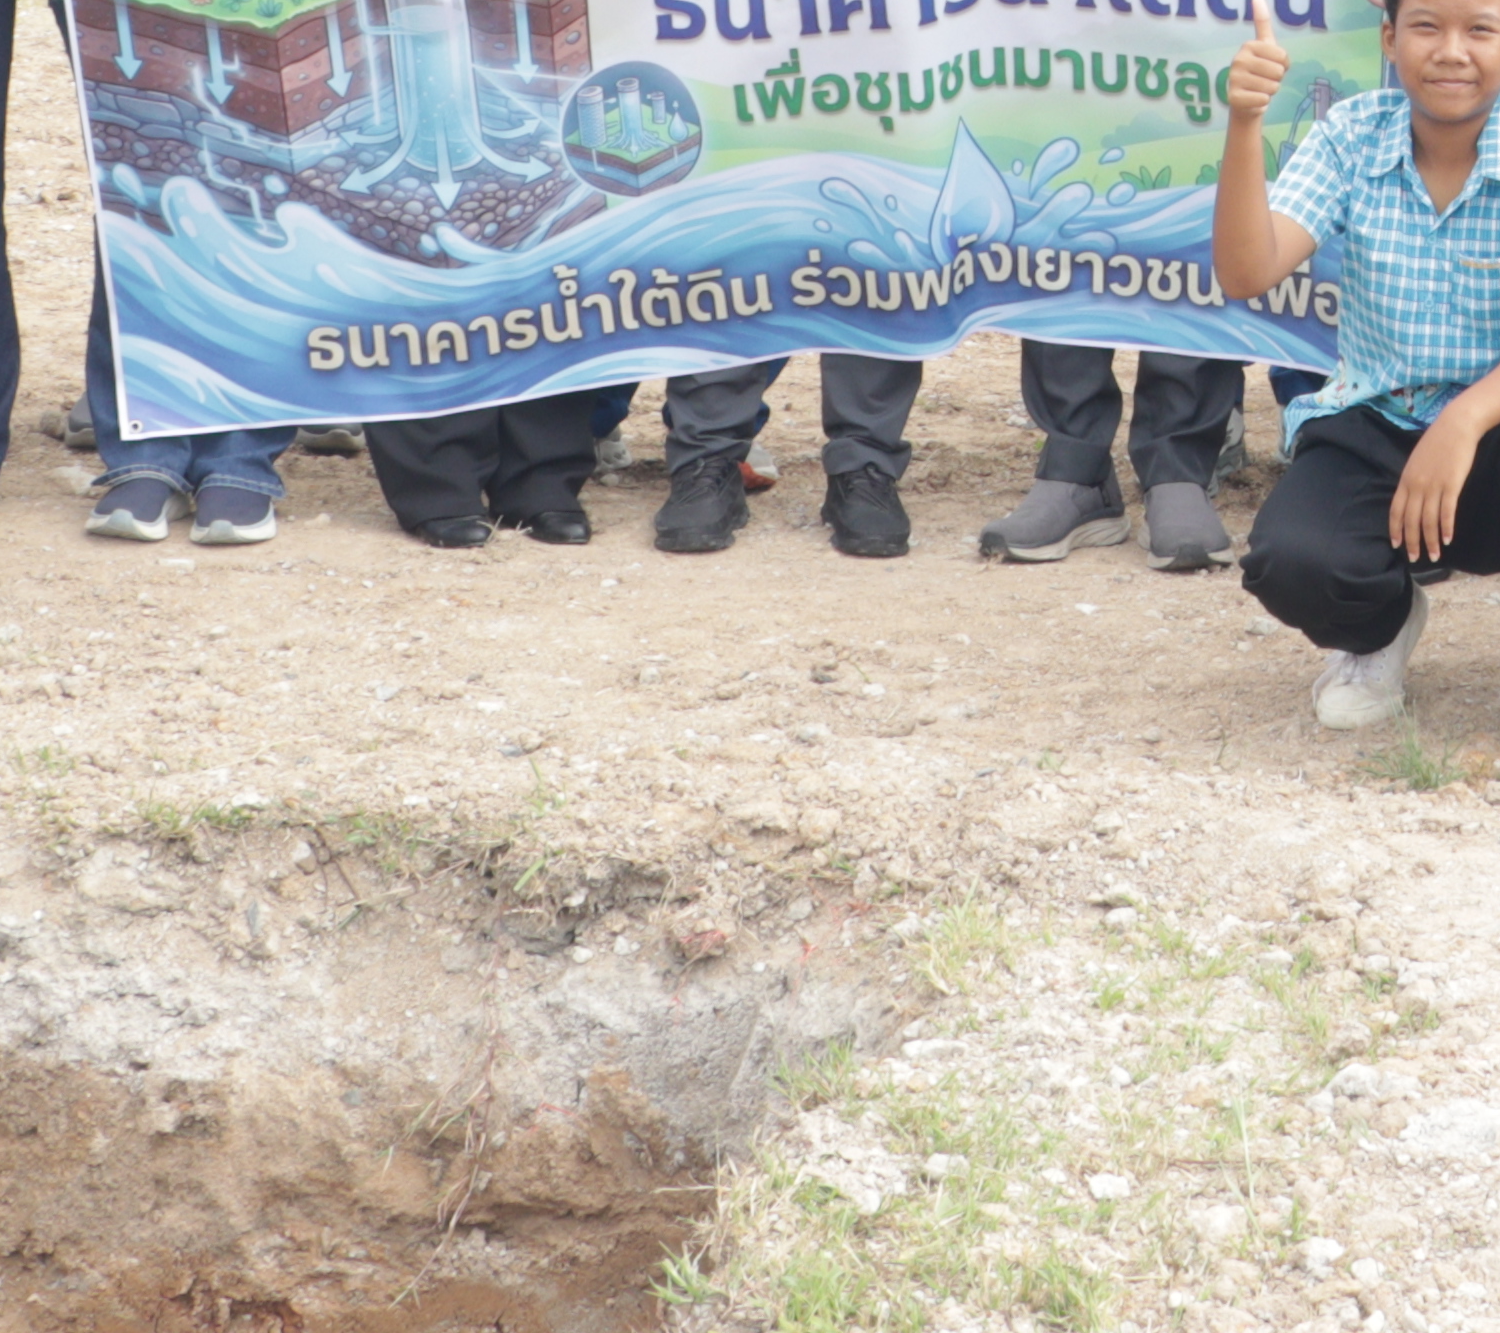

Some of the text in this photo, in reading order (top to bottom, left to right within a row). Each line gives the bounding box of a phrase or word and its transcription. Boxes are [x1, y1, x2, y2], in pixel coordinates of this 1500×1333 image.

[733, 46, 1233, 130] เพื่อชุมชนมาบชลู
[308, 265, 773, 371] ธนาคารน้ำใต้ดิน
[790, 235, 1225, 312] ร่วมพลังเยาวชน
